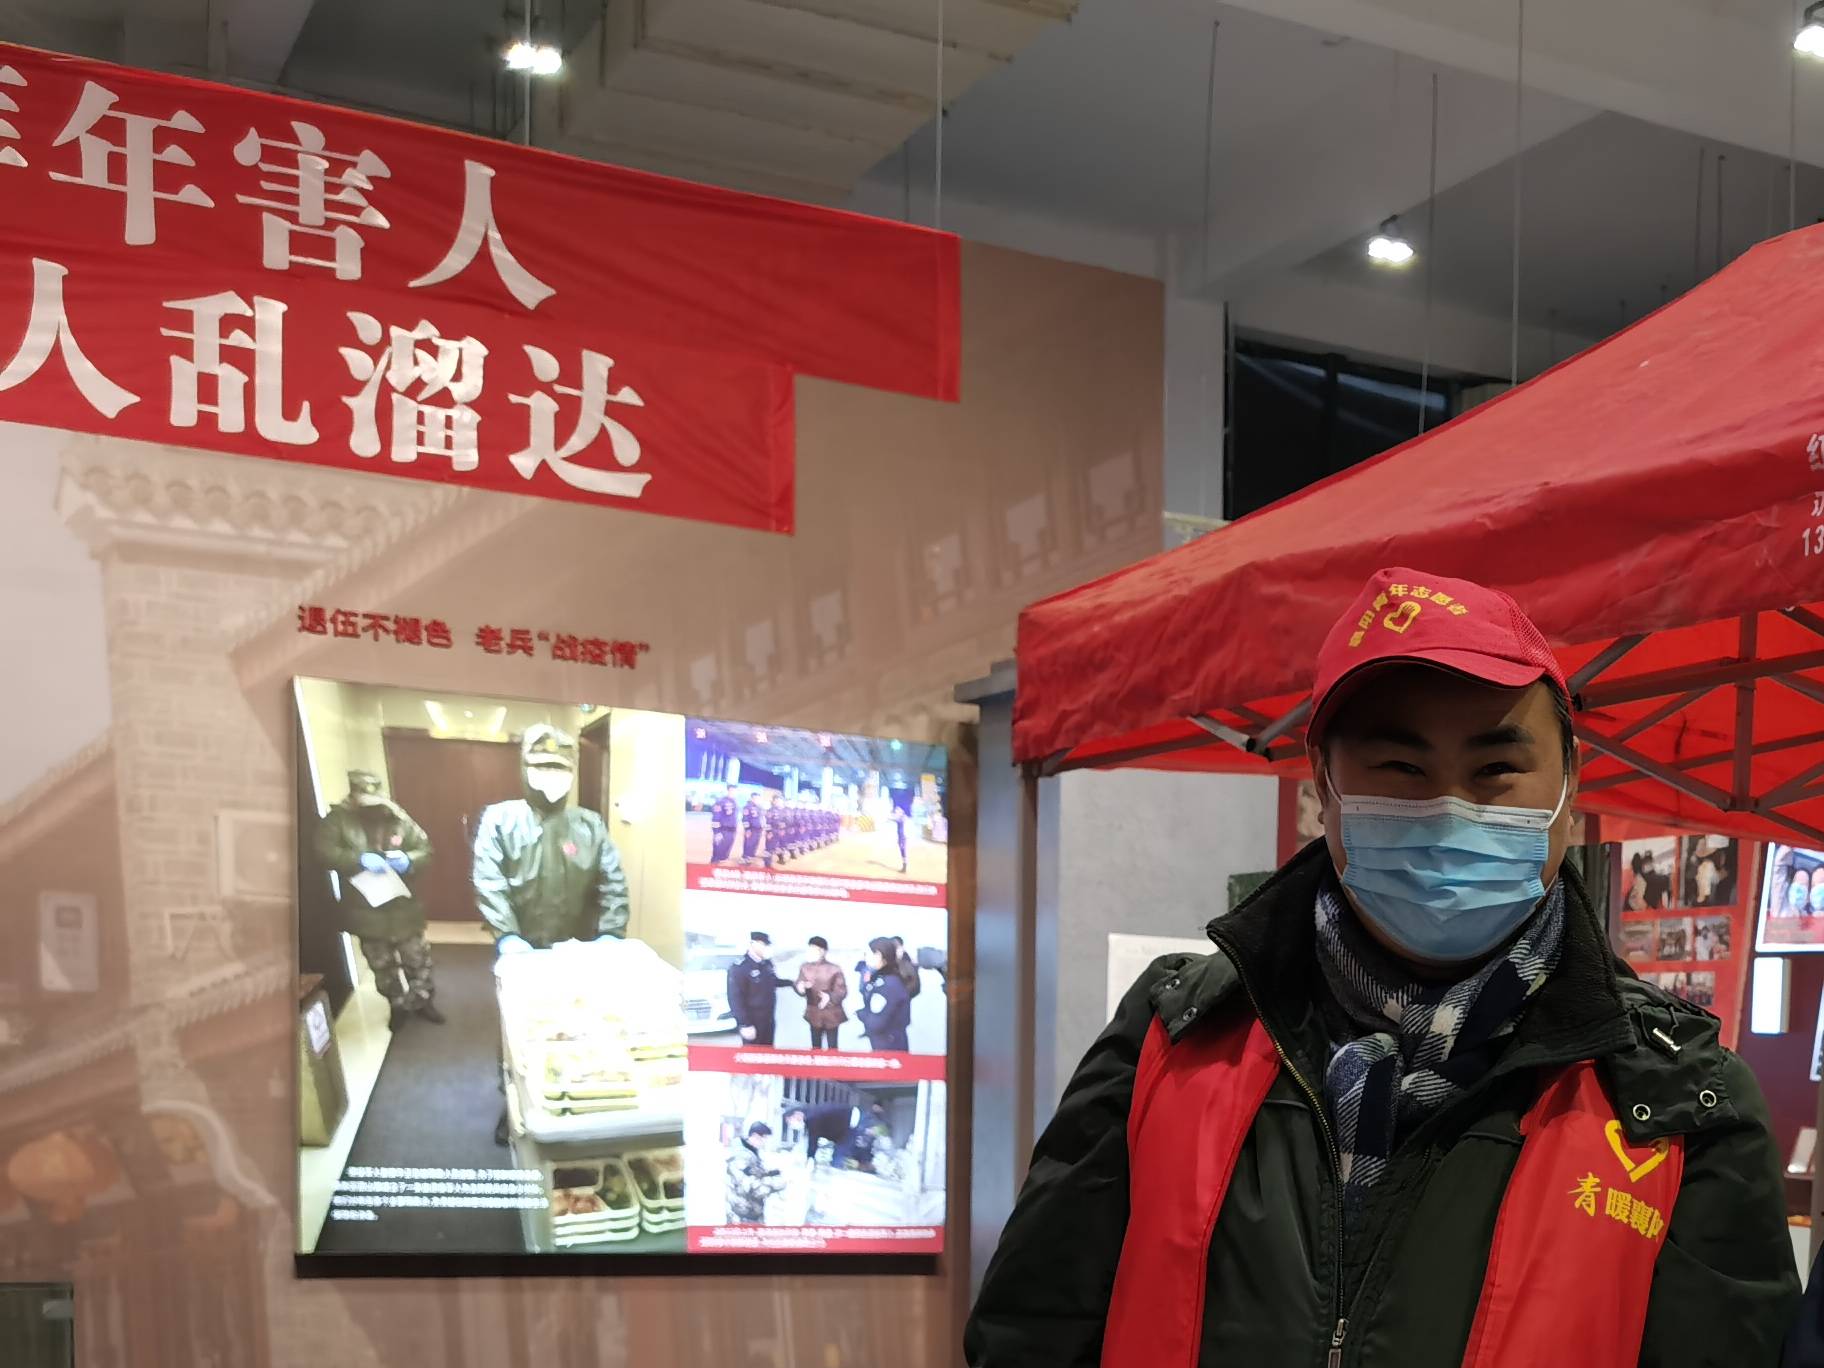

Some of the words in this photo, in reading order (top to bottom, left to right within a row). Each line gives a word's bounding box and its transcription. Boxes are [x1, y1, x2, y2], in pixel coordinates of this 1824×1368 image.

[0, 65, 556, 310] 年害人
[0, 257, 652, 498] 人乱溜达
[297, 604, 453, 649] 退伍不褪色
